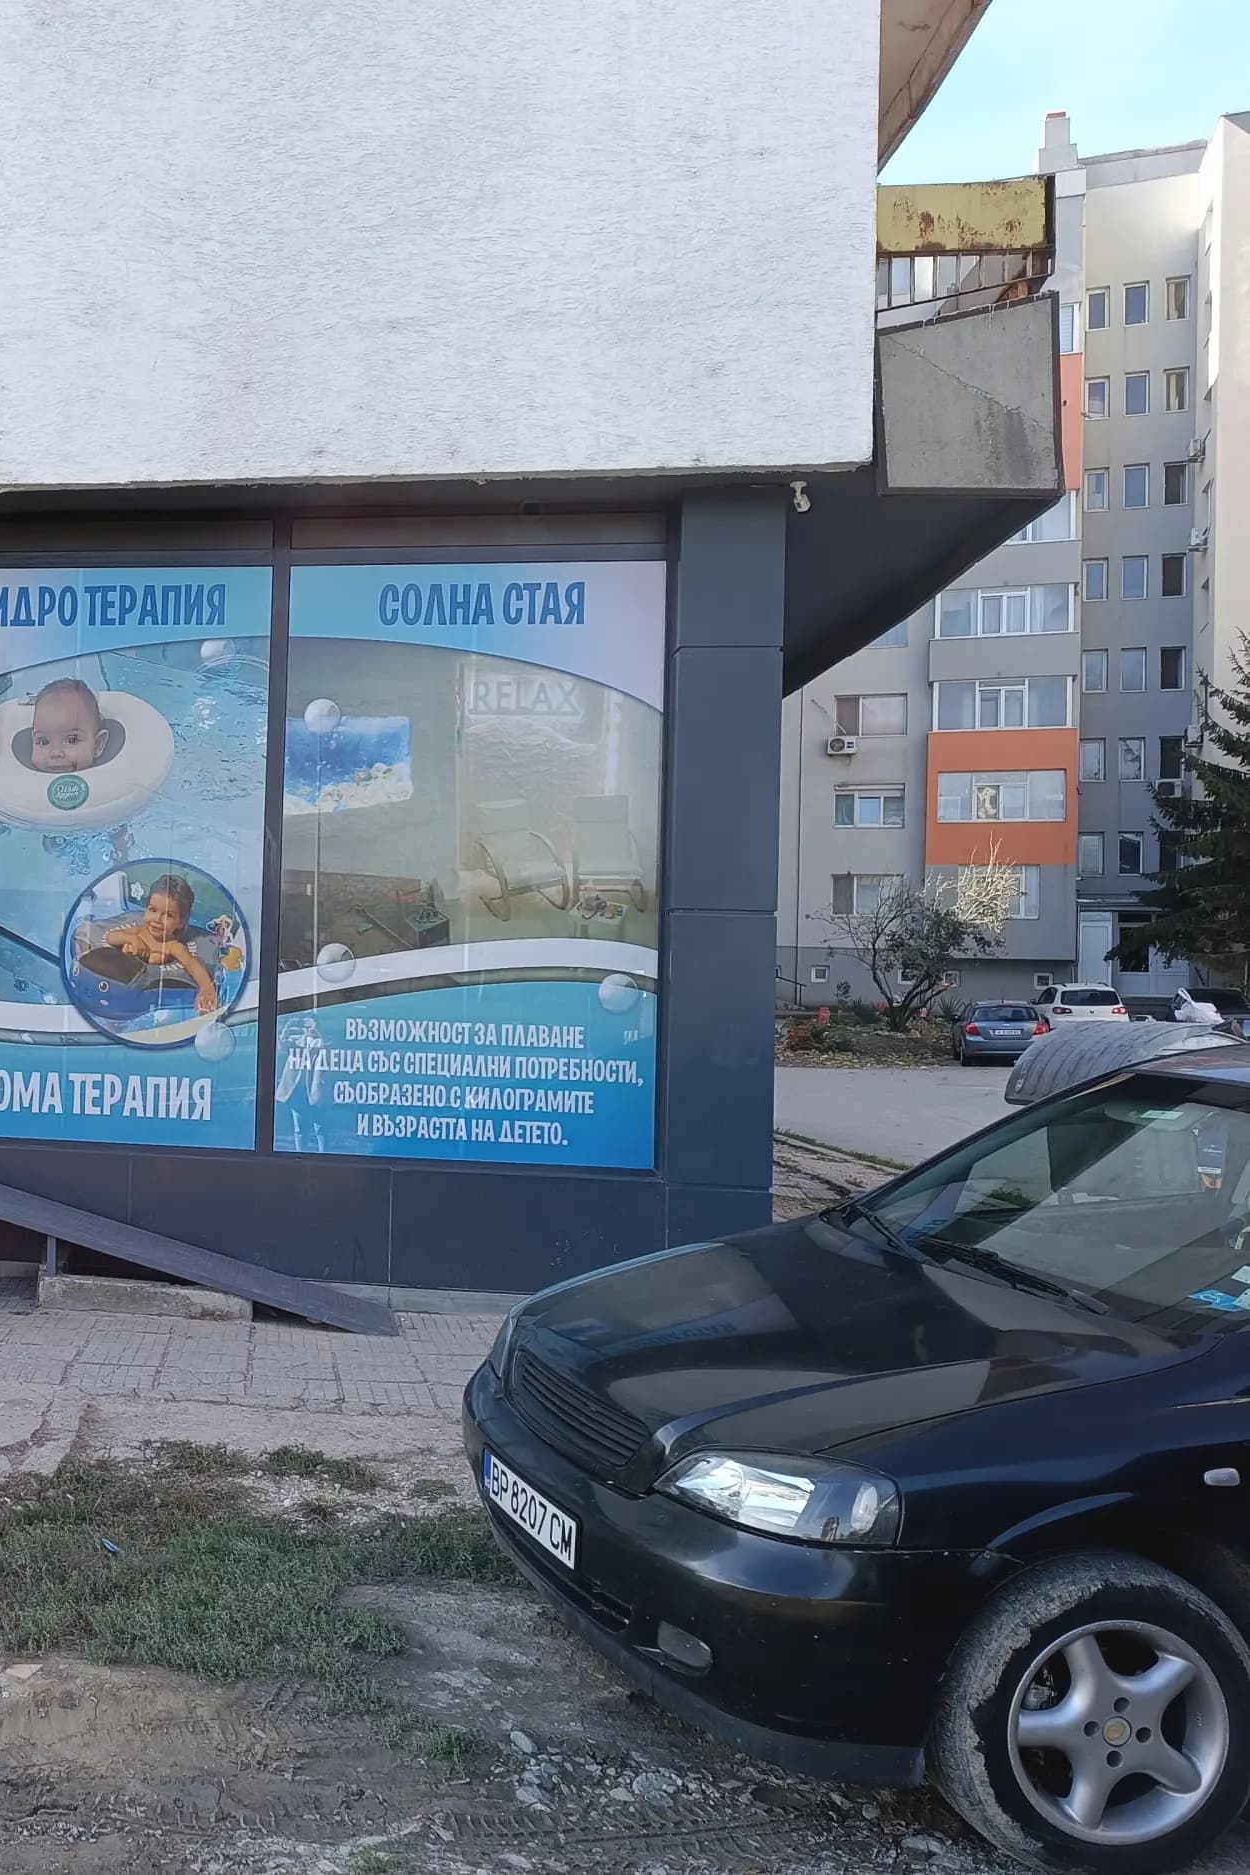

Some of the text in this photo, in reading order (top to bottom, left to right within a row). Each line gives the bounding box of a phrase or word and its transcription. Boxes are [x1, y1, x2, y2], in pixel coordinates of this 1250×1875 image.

[85, 584, 226, 626] ТЕРАПИЯ
[380, 582, 585, 625] СОЛНА СТАЯ
[470, 680, 581, 715] RELAX
[346, 1019, 584, 1049] ВЪЗМОЖНОСТ ЗА ПЛАВАНЕ
[289, 1048, 643, 1086] НА ДЕЦА СЪС СПЕЦИАЛНИ ПОТРЕБНОСТИ,
[69, 1073, 212, 1121] ТЕРАПИЯ
[334, 1080, 594, 1114] СЪОБРАЗЕНО С КИЛОГРАМИТЕ
[357, 1114, 568, 1146] И ВЪЗРАСТТА НА ДЕТЕТО.
[492, 1461, 572, 1561] BP 8207 CM
